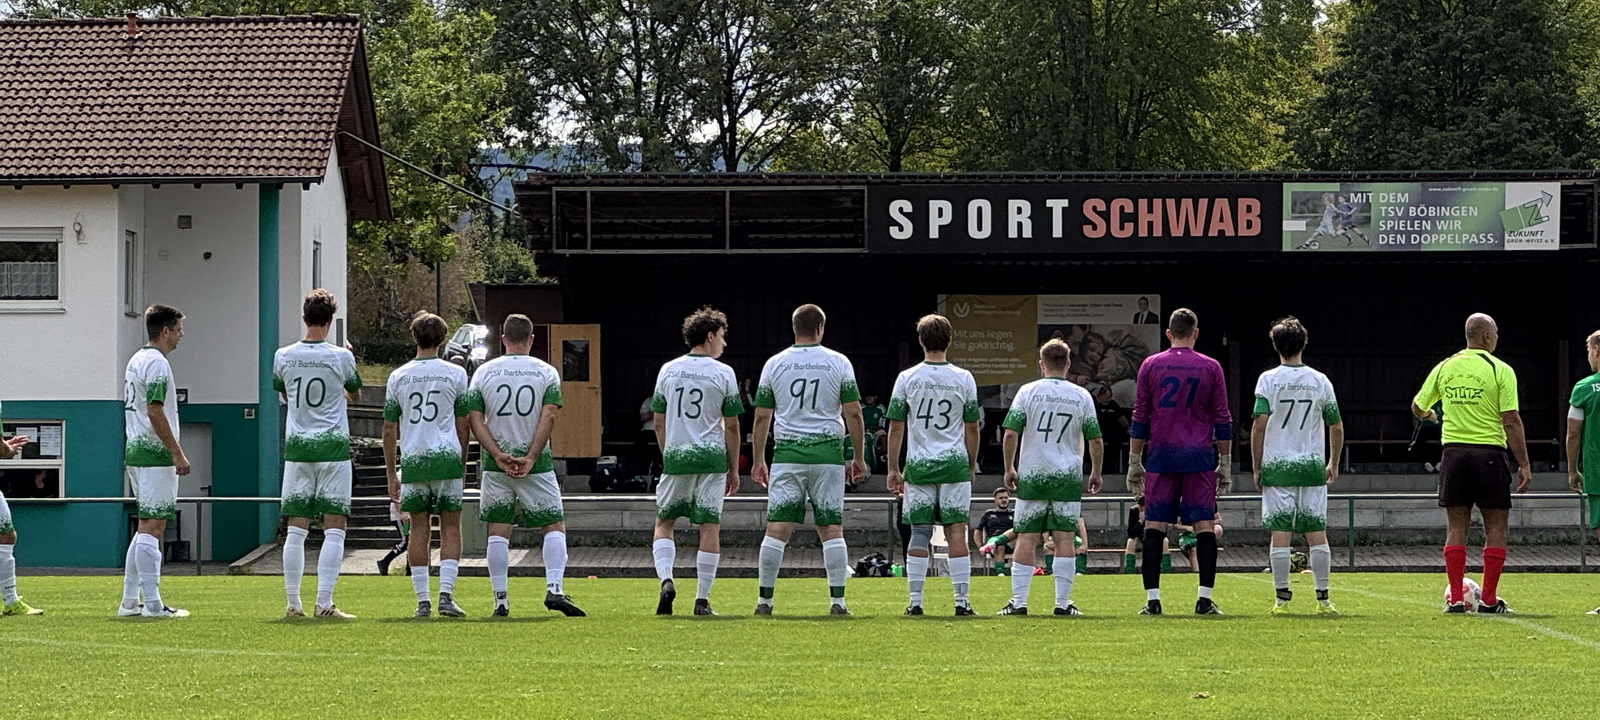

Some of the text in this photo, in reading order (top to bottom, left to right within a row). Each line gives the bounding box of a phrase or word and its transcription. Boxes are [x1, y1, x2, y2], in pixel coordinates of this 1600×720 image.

[1350, 192, 1409, 203] MIT DEM
[1380, 203, 1478, 217] TSV BÖBINGEN
[888, 198, 1262, 240] SPORT SCHWAB
[1379, 220, 1462, 230] SPIELEN WIR
[1379, 233, 1498, 244] DEN DOPPELPASS.
[954, 330, 968, 338] Mit
[970, 330, 986, 338] uns
[954, 341, 1016, 352] Sie goldrichtig.
[400, 375, 412, 385] TSV
[668, 370, 679, 378] TSV
[293, 376, 326, 408] 10
[408, 390, 440, 424] 35
[496, 384, 536, 417] 20
[675, 387, 704, 420] 13
[790, 378, 820, 410] 91
[1159, 376, 1200, 408] 21
[1444, 386, 1484, 400] STÜTZ
[916, 398, 952, 430] 43
[1037, 410, 1073, 444] 47
[1280, 399, 1313, 430] 77
